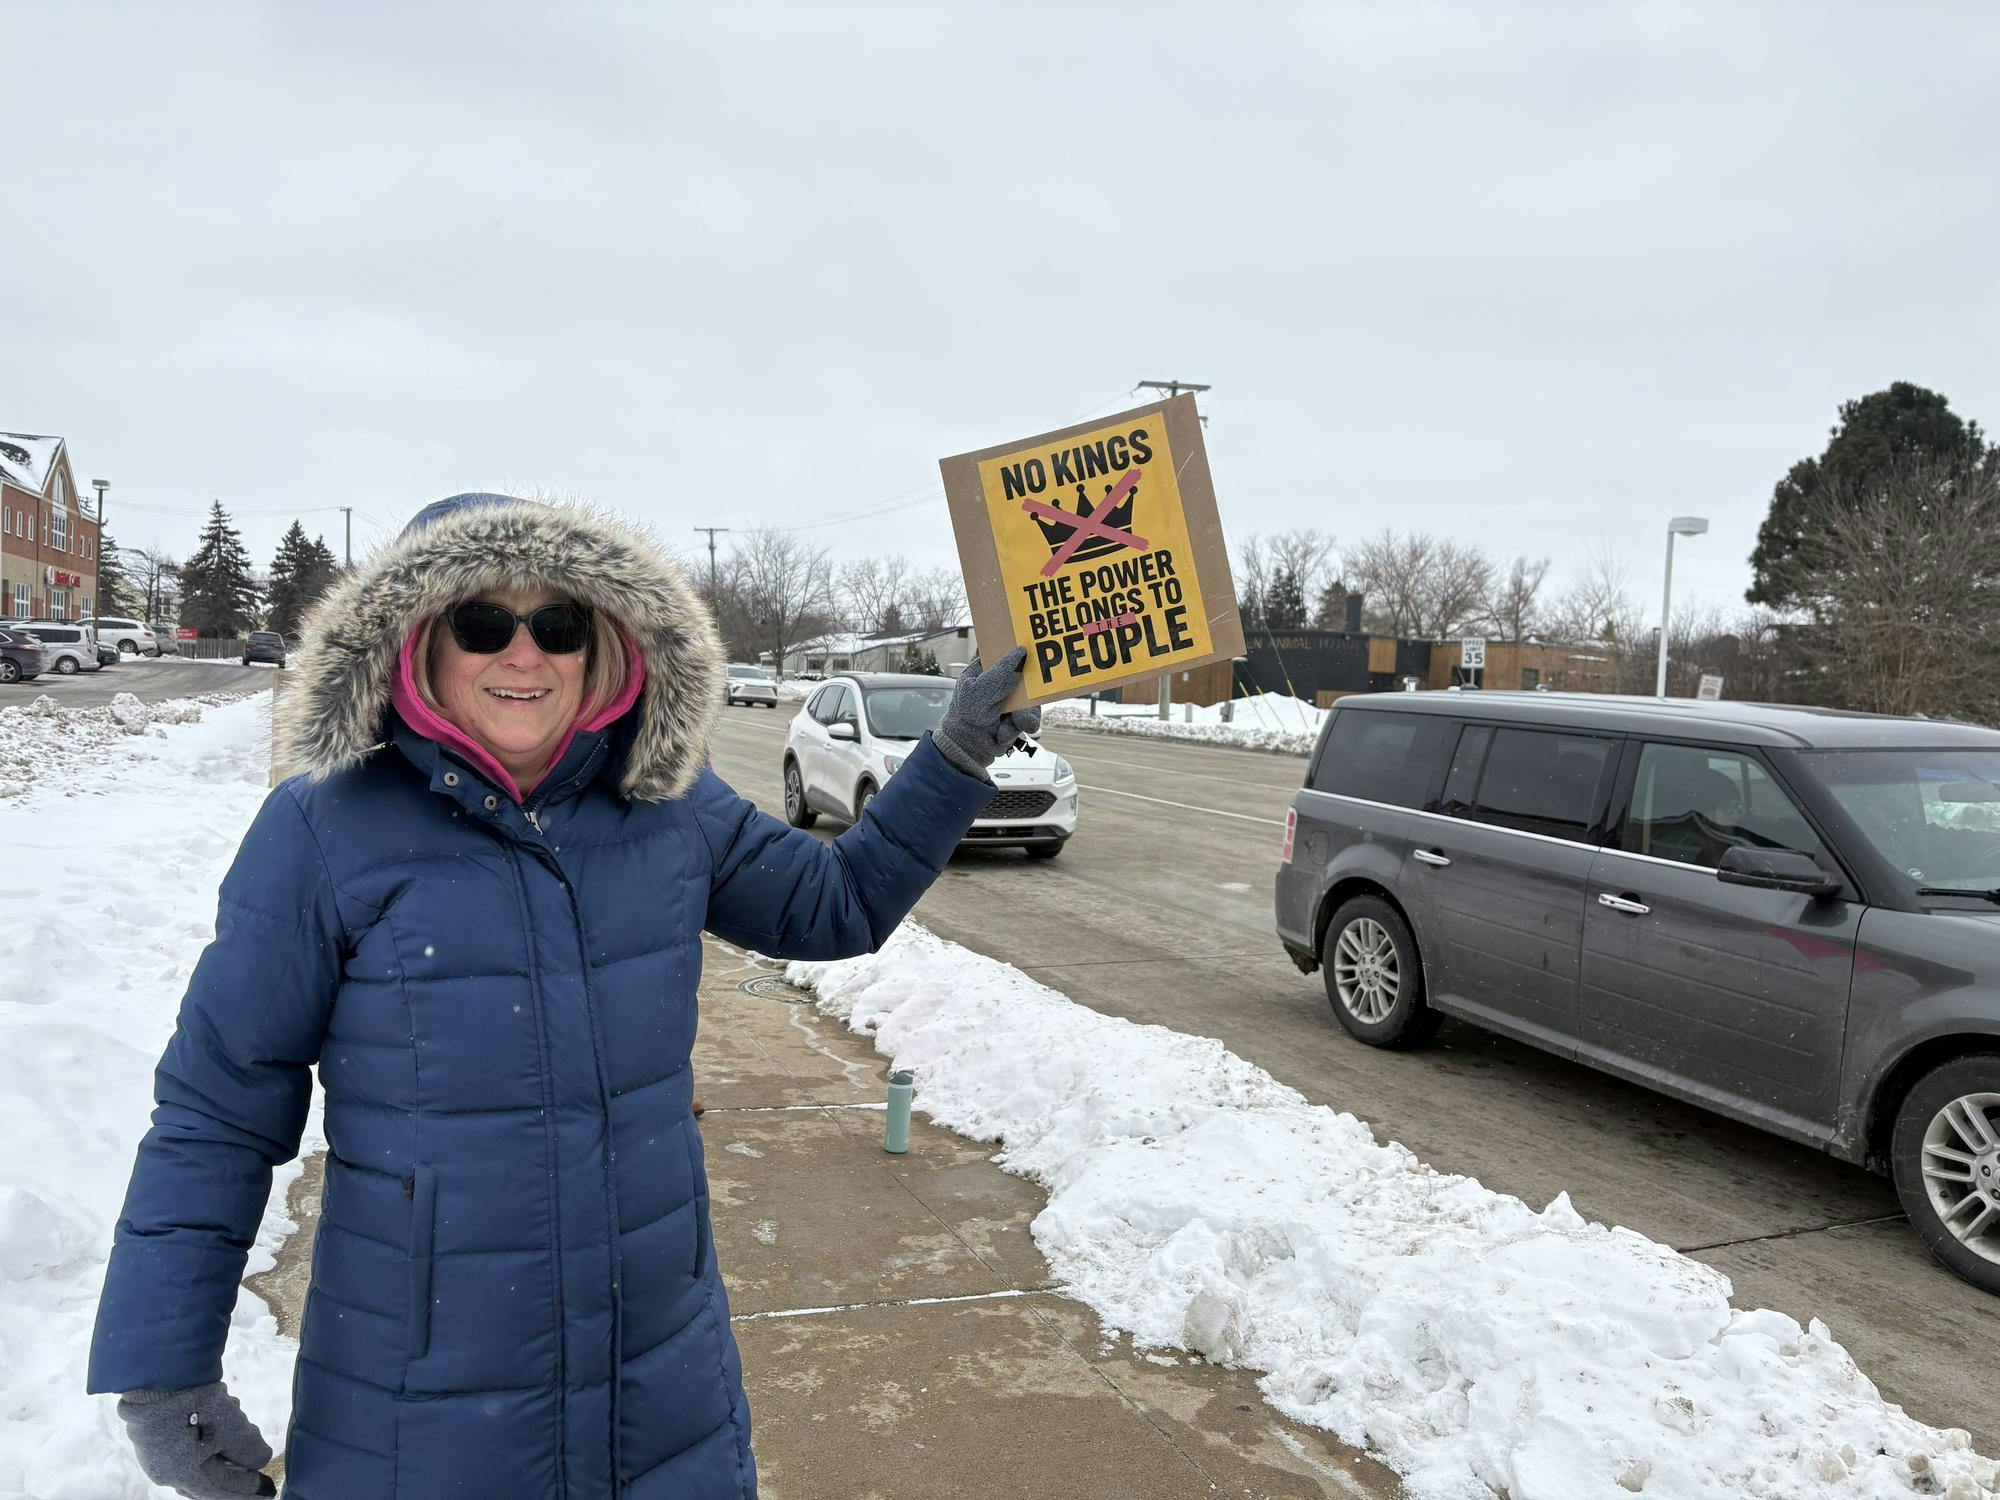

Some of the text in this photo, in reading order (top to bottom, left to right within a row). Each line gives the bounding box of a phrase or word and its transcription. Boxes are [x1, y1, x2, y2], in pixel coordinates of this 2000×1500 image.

[1000, 429, 1153, 500] NO KINGS
[1023, 550, 1175, 611] THE POWER
[1029, 577, 1183, 640] BELONGS TO
[1035, 605, 1194, 684] PEOPLE
[1096, 616, 1123, 631] THE
[1464, 653, 1483, 664] 35
